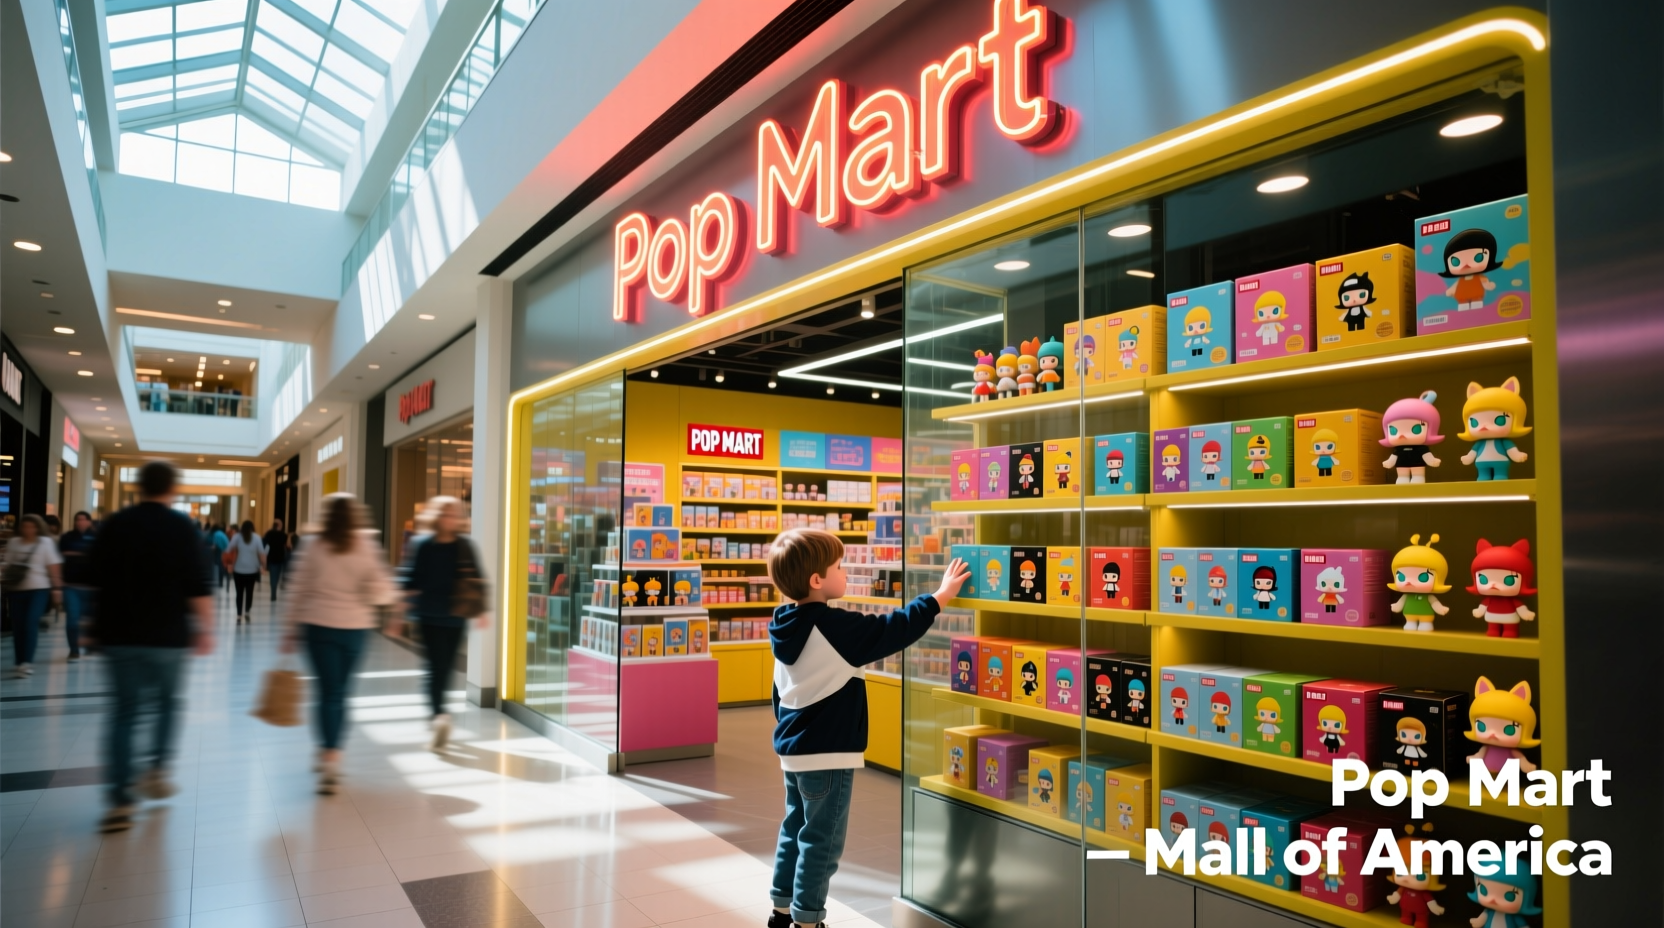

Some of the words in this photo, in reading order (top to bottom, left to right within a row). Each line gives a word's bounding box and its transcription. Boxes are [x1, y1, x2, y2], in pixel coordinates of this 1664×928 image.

[612, 191, 744, 320] Pop
[756, 0, 1058, 254] Mart
[690, 428, 721, 452] POP
[722, 430, 762, 455] MART
